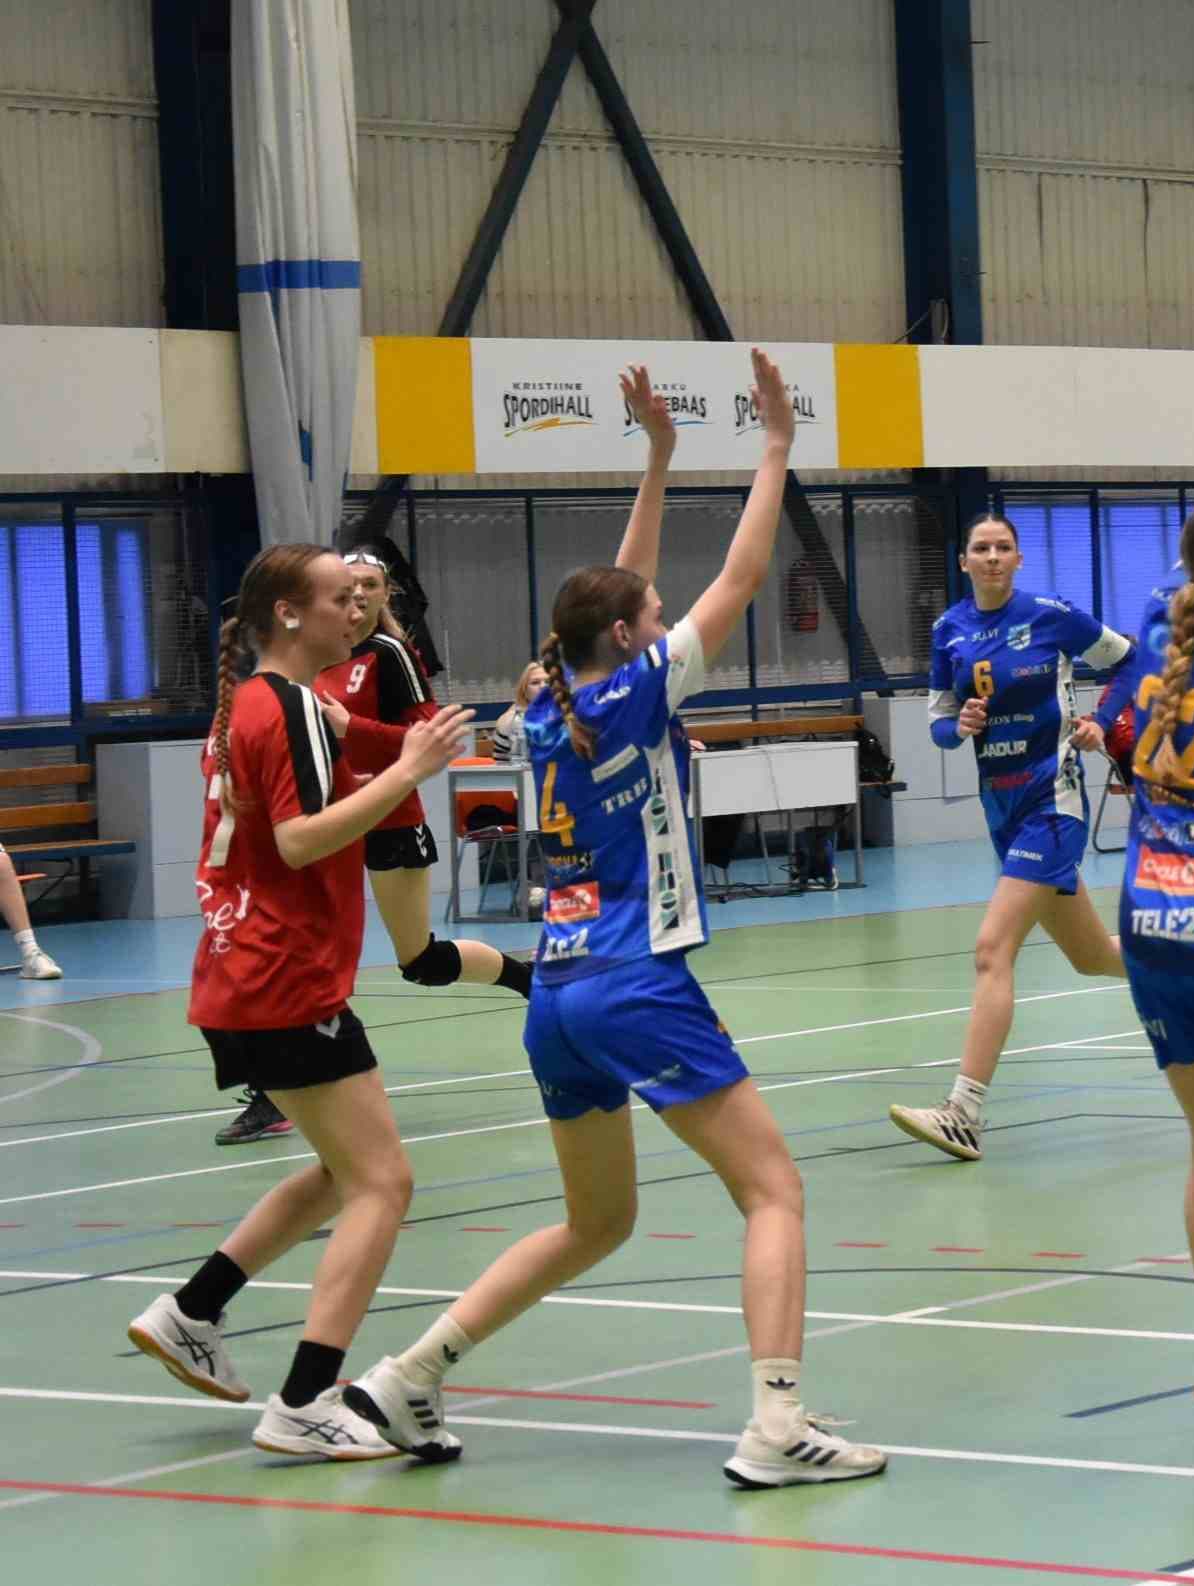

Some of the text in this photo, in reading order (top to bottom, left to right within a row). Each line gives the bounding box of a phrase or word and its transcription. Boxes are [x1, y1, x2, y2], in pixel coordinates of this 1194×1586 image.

[513, 382, 584, 391] KRISTIINE
[504, 393, 593, 428] SPORDIHALL
[735, 394, 816, 427] SPOALL
[346, 663, 367, 694] 9
[973, 660, 994, 697] 6
[539, 761, 575, 847] 4
